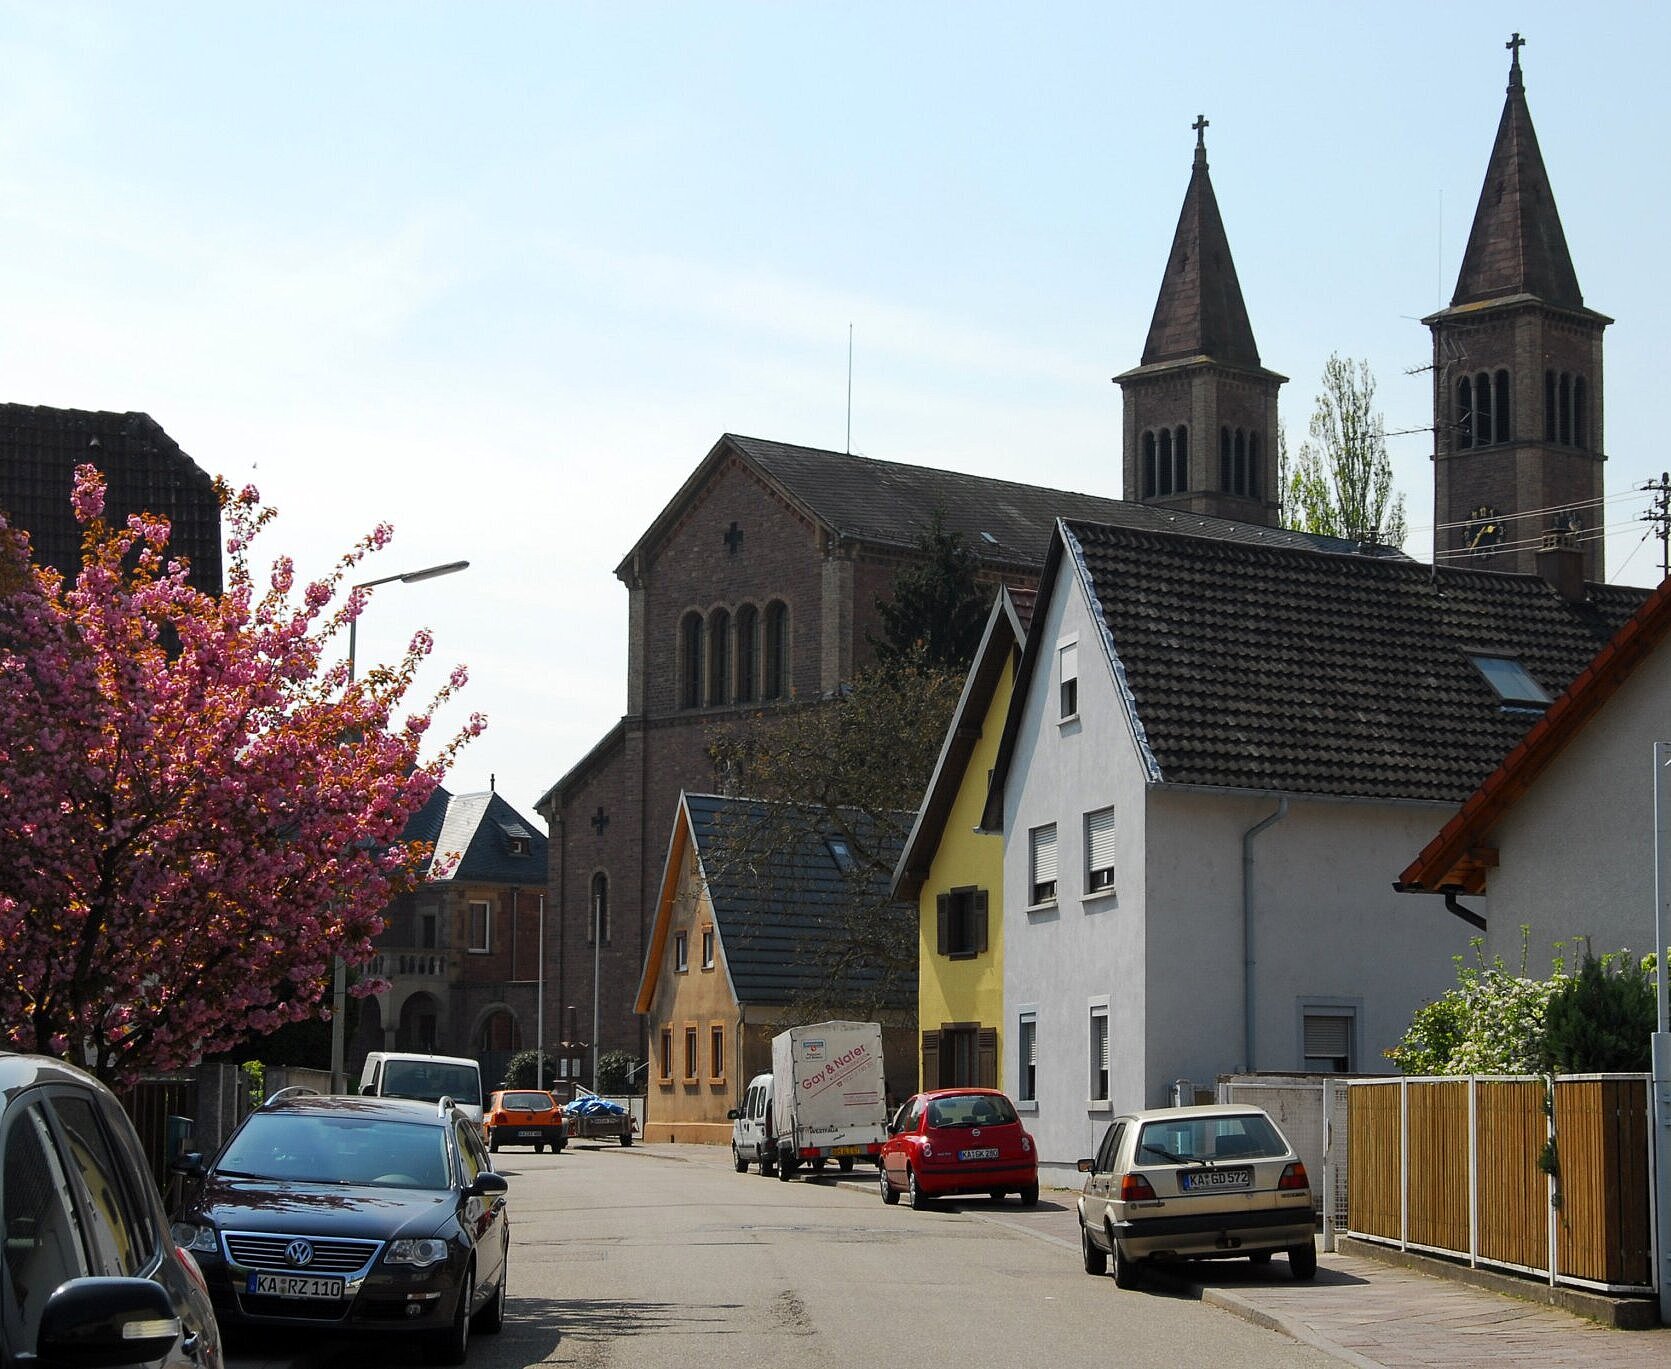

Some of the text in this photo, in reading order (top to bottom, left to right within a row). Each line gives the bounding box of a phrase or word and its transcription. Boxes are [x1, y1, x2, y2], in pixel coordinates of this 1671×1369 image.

[802, 1071, 826, 1089] Gay
[825, 1064, 835, 1075] &
[833, 1044, 866, 1069] Nater
[962, 1151, 972, 1159] KA
[1189, 1171, 1248, 1186] KA GD 572
[257, 1276, 340, 1297] KA RZ 110
